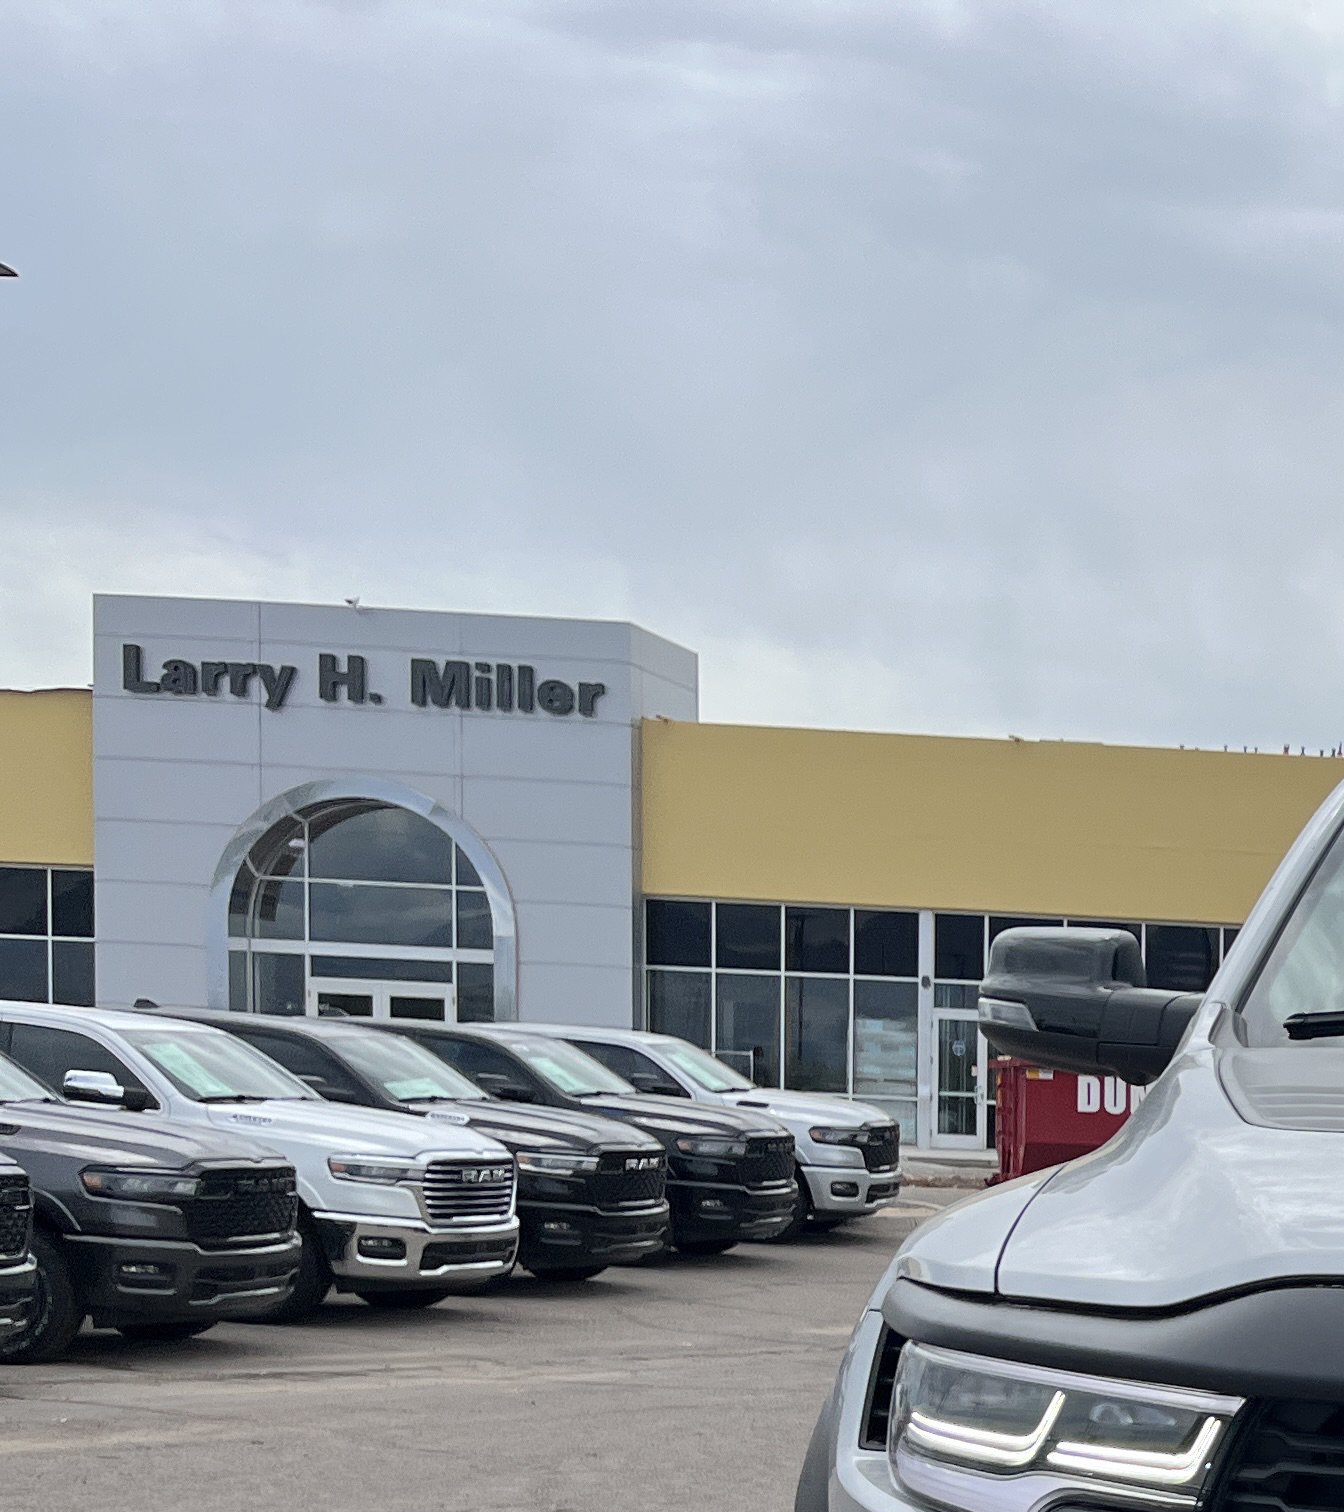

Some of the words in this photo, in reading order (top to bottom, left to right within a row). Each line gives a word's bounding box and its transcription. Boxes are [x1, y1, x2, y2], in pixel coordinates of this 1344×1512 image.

[122, 643, 298, 711] Larry
[318, 652, 384, 705] H.
[410, 657, 606, 718] Miller
